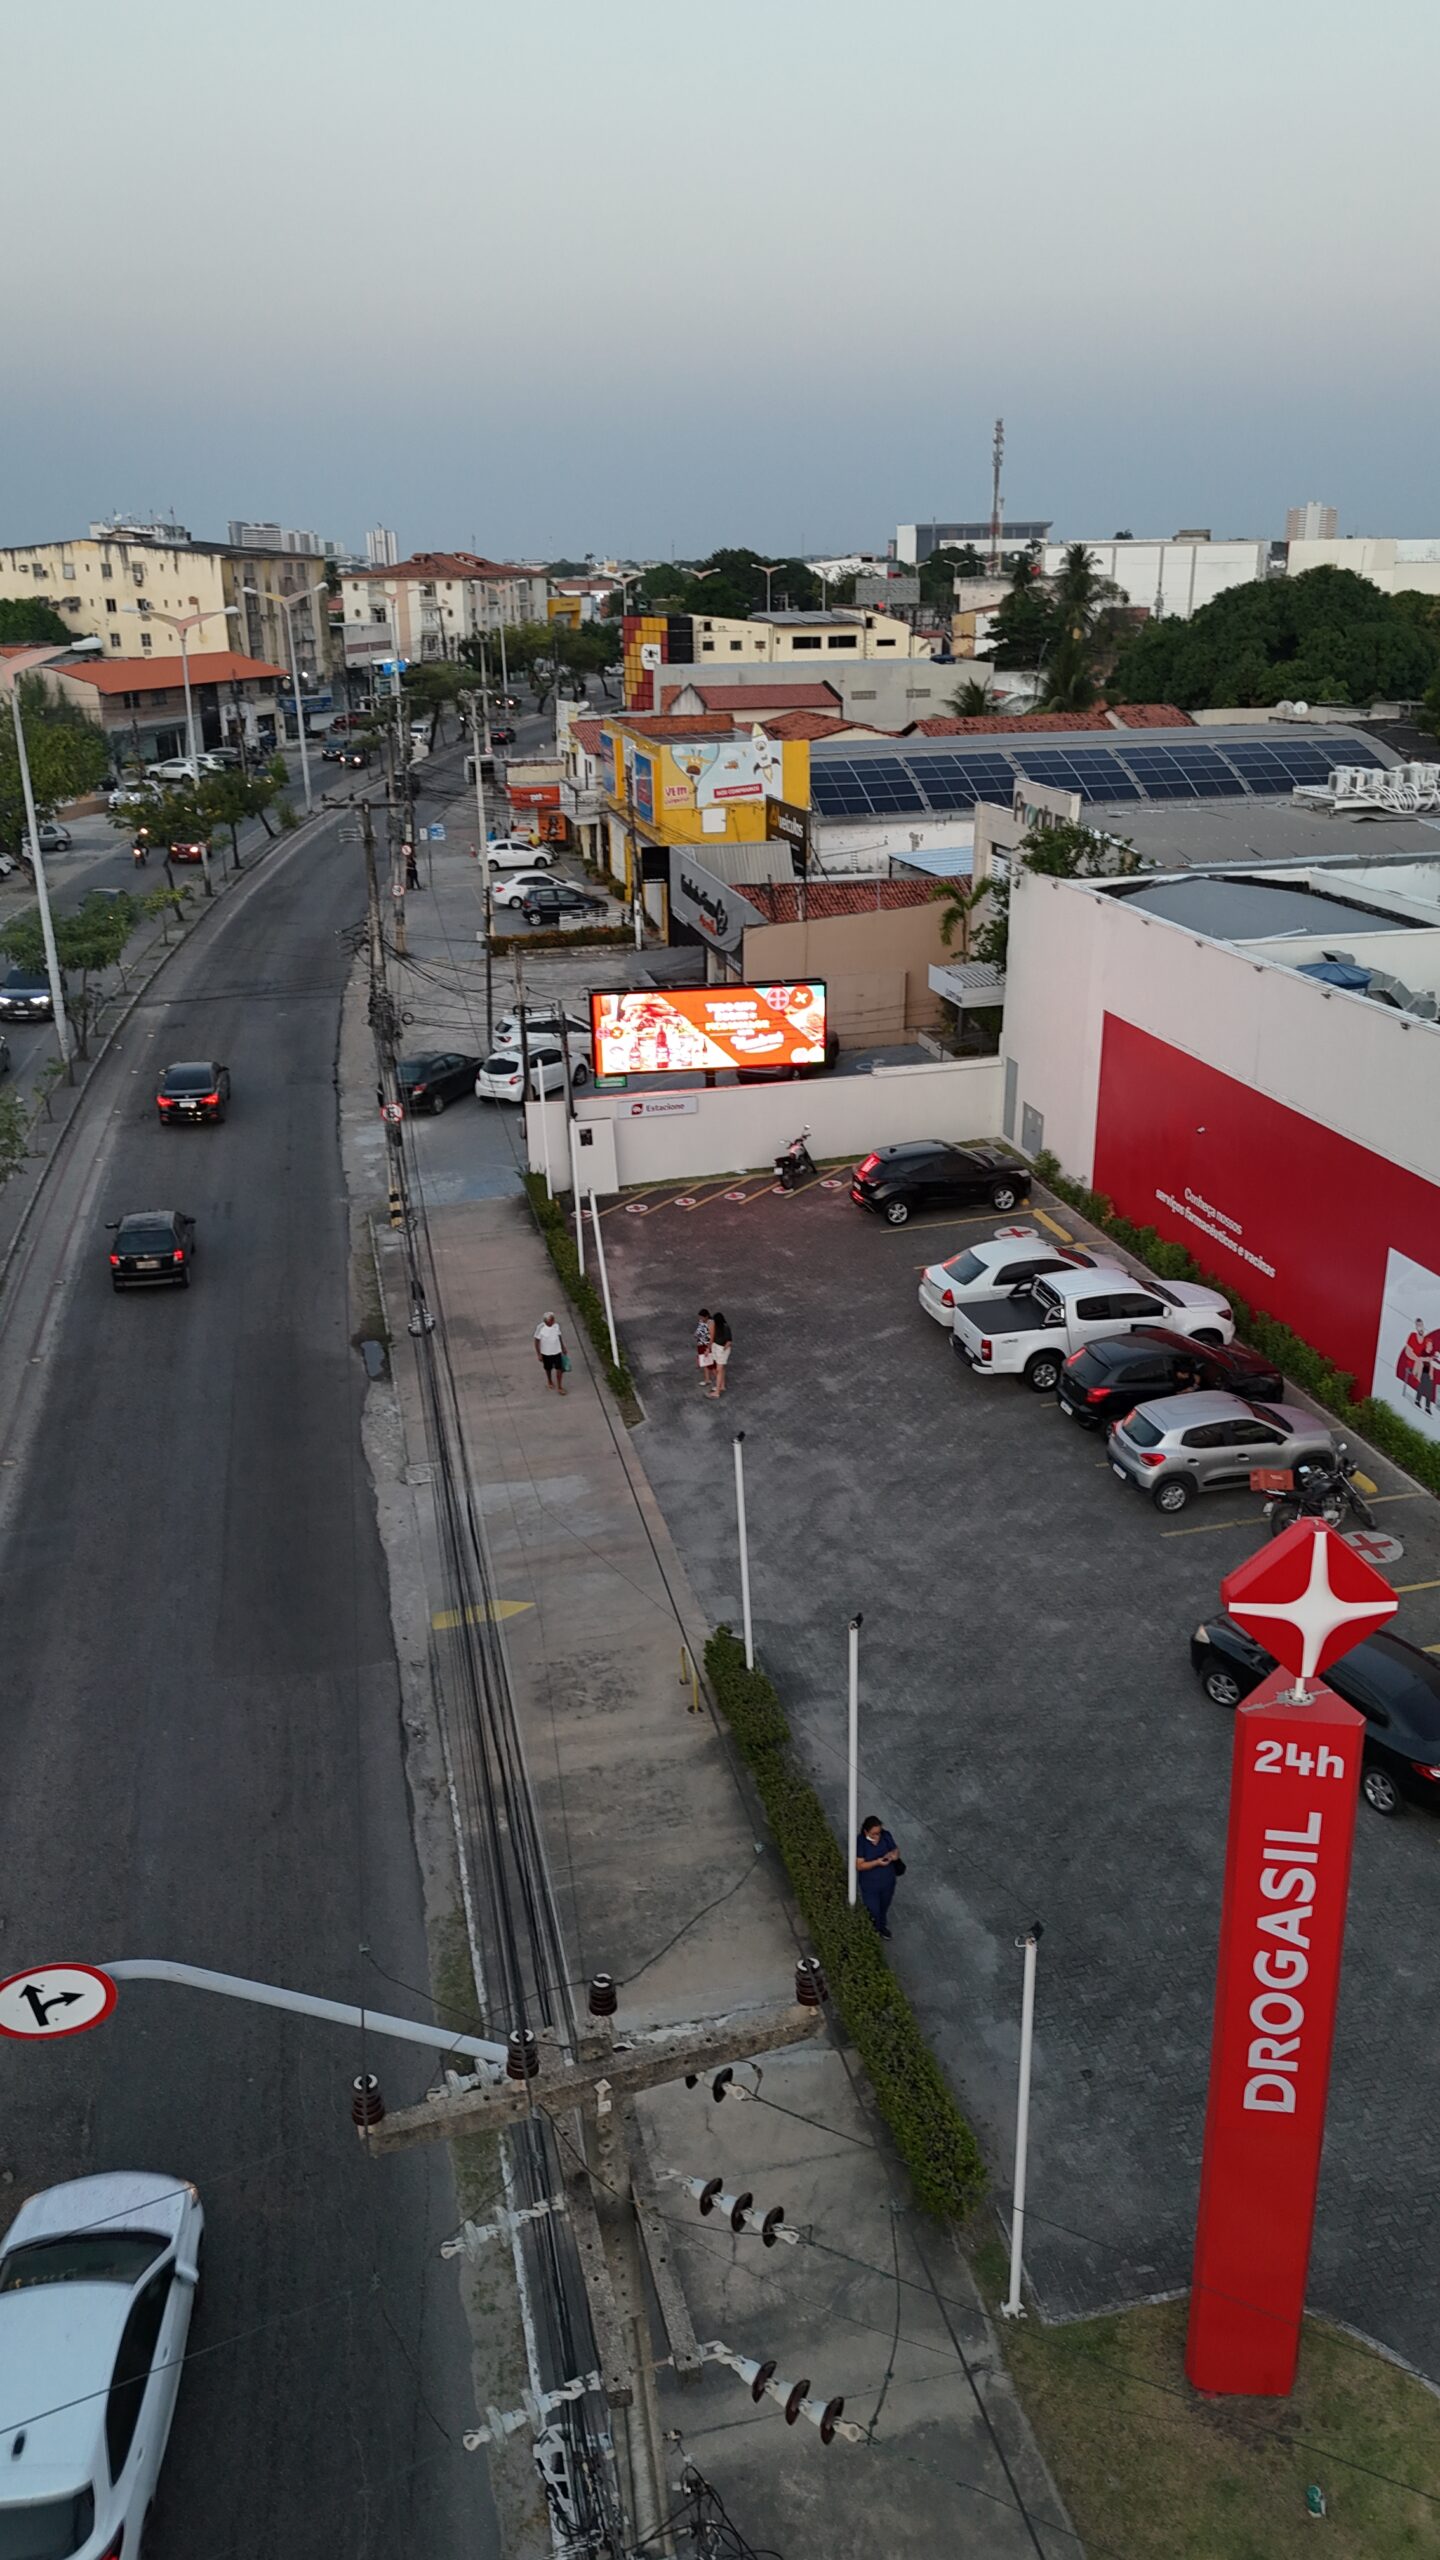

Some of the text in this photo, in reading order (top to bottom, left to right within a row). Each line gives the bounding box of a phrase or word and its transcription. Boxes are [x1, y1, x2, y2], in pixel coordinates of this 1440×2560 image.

[646, 1102, 685, 1112] Estacione
[1155, 1189, 1276, 1278] serviços farmacêuticos e vacinas
[1184, 1187, 1242, 1235] Conheça nossos
[1253, 1740, 1345, 1779] 24h
[1243, 1811, 1322, 2113] DROGASIL
